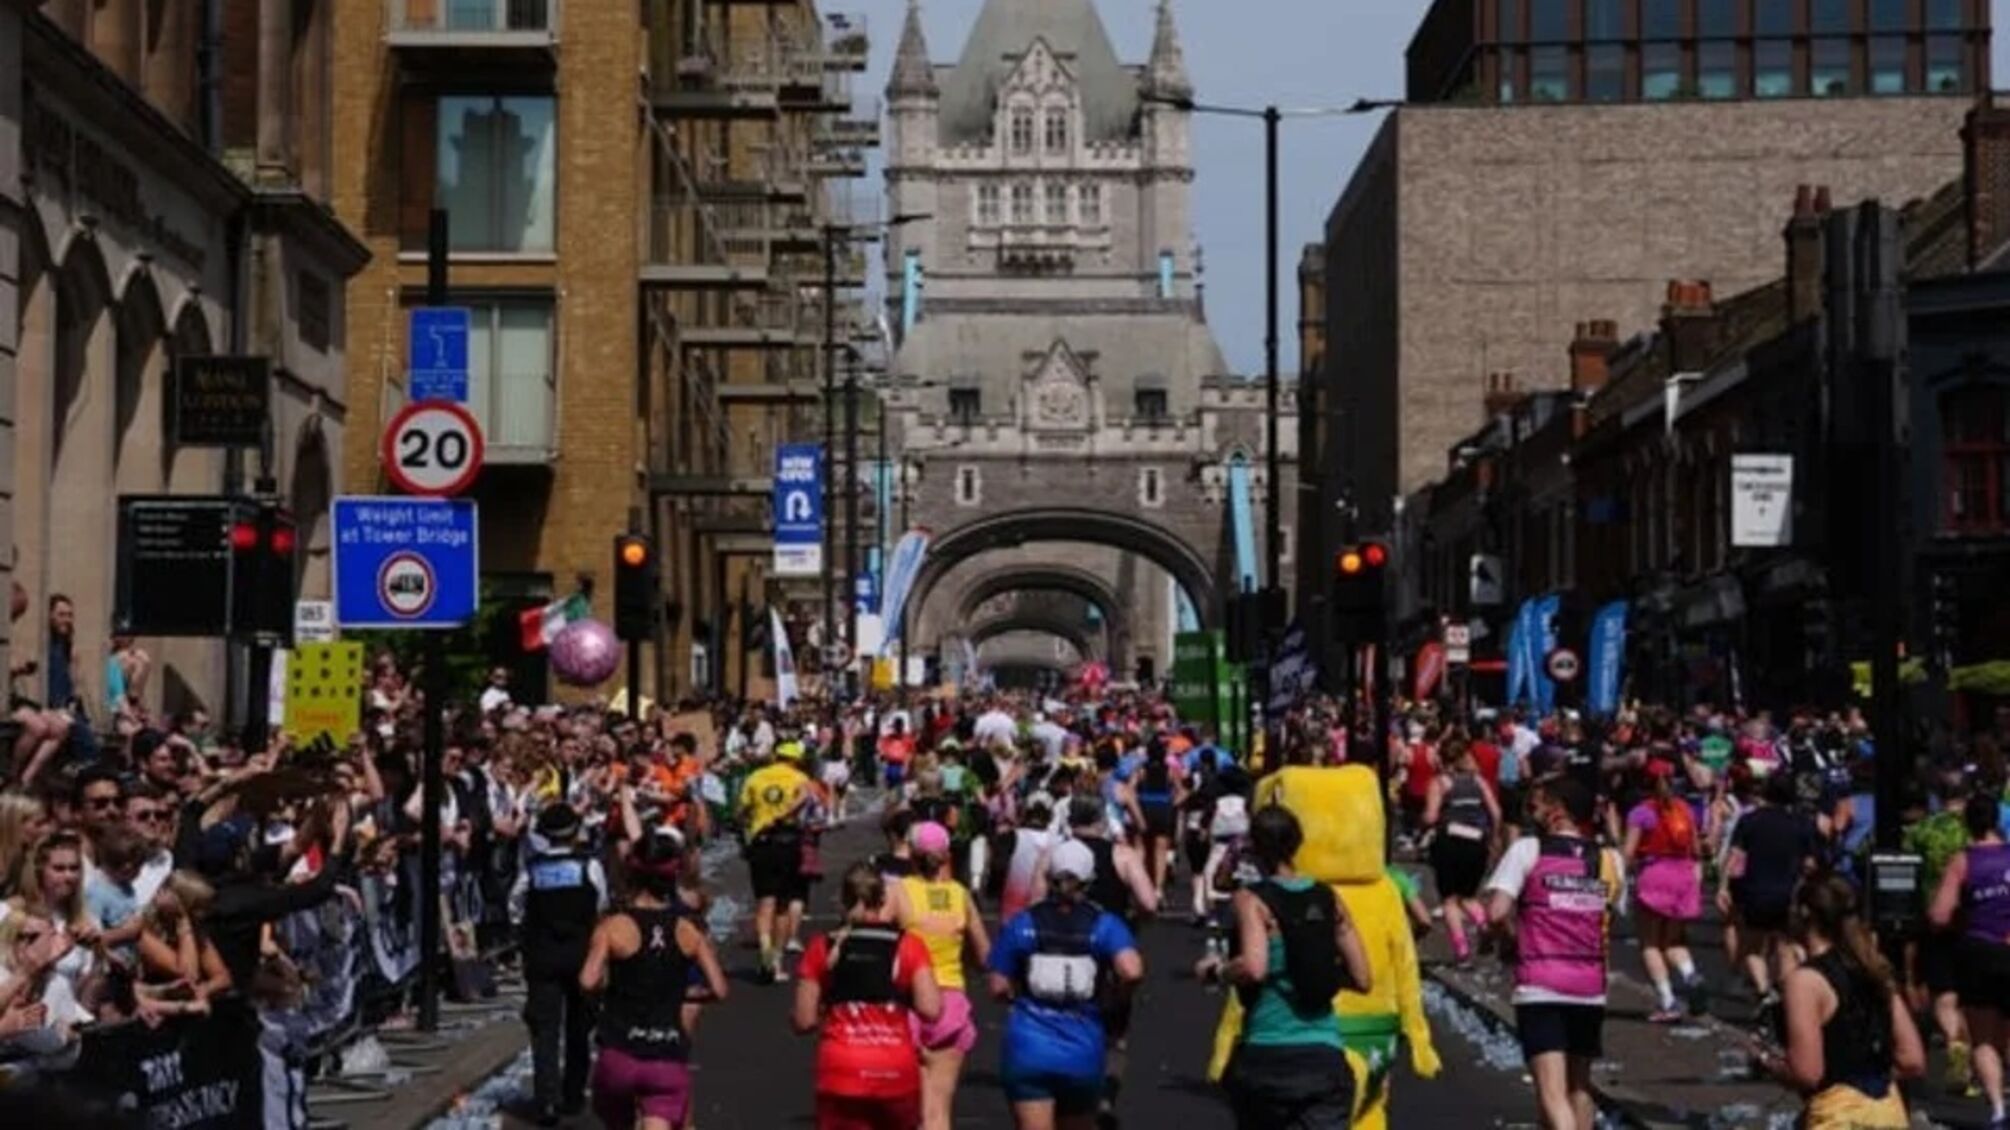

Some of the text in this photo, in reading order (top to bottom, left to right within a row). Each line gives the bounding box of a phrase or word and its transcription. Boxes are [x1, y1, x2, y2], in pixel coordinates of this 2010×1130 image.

[402, 429, 467, 469] 20
[355, 507, 453, 526] Weight limit
[341, 527, 468, 546] at Tower Bridge
